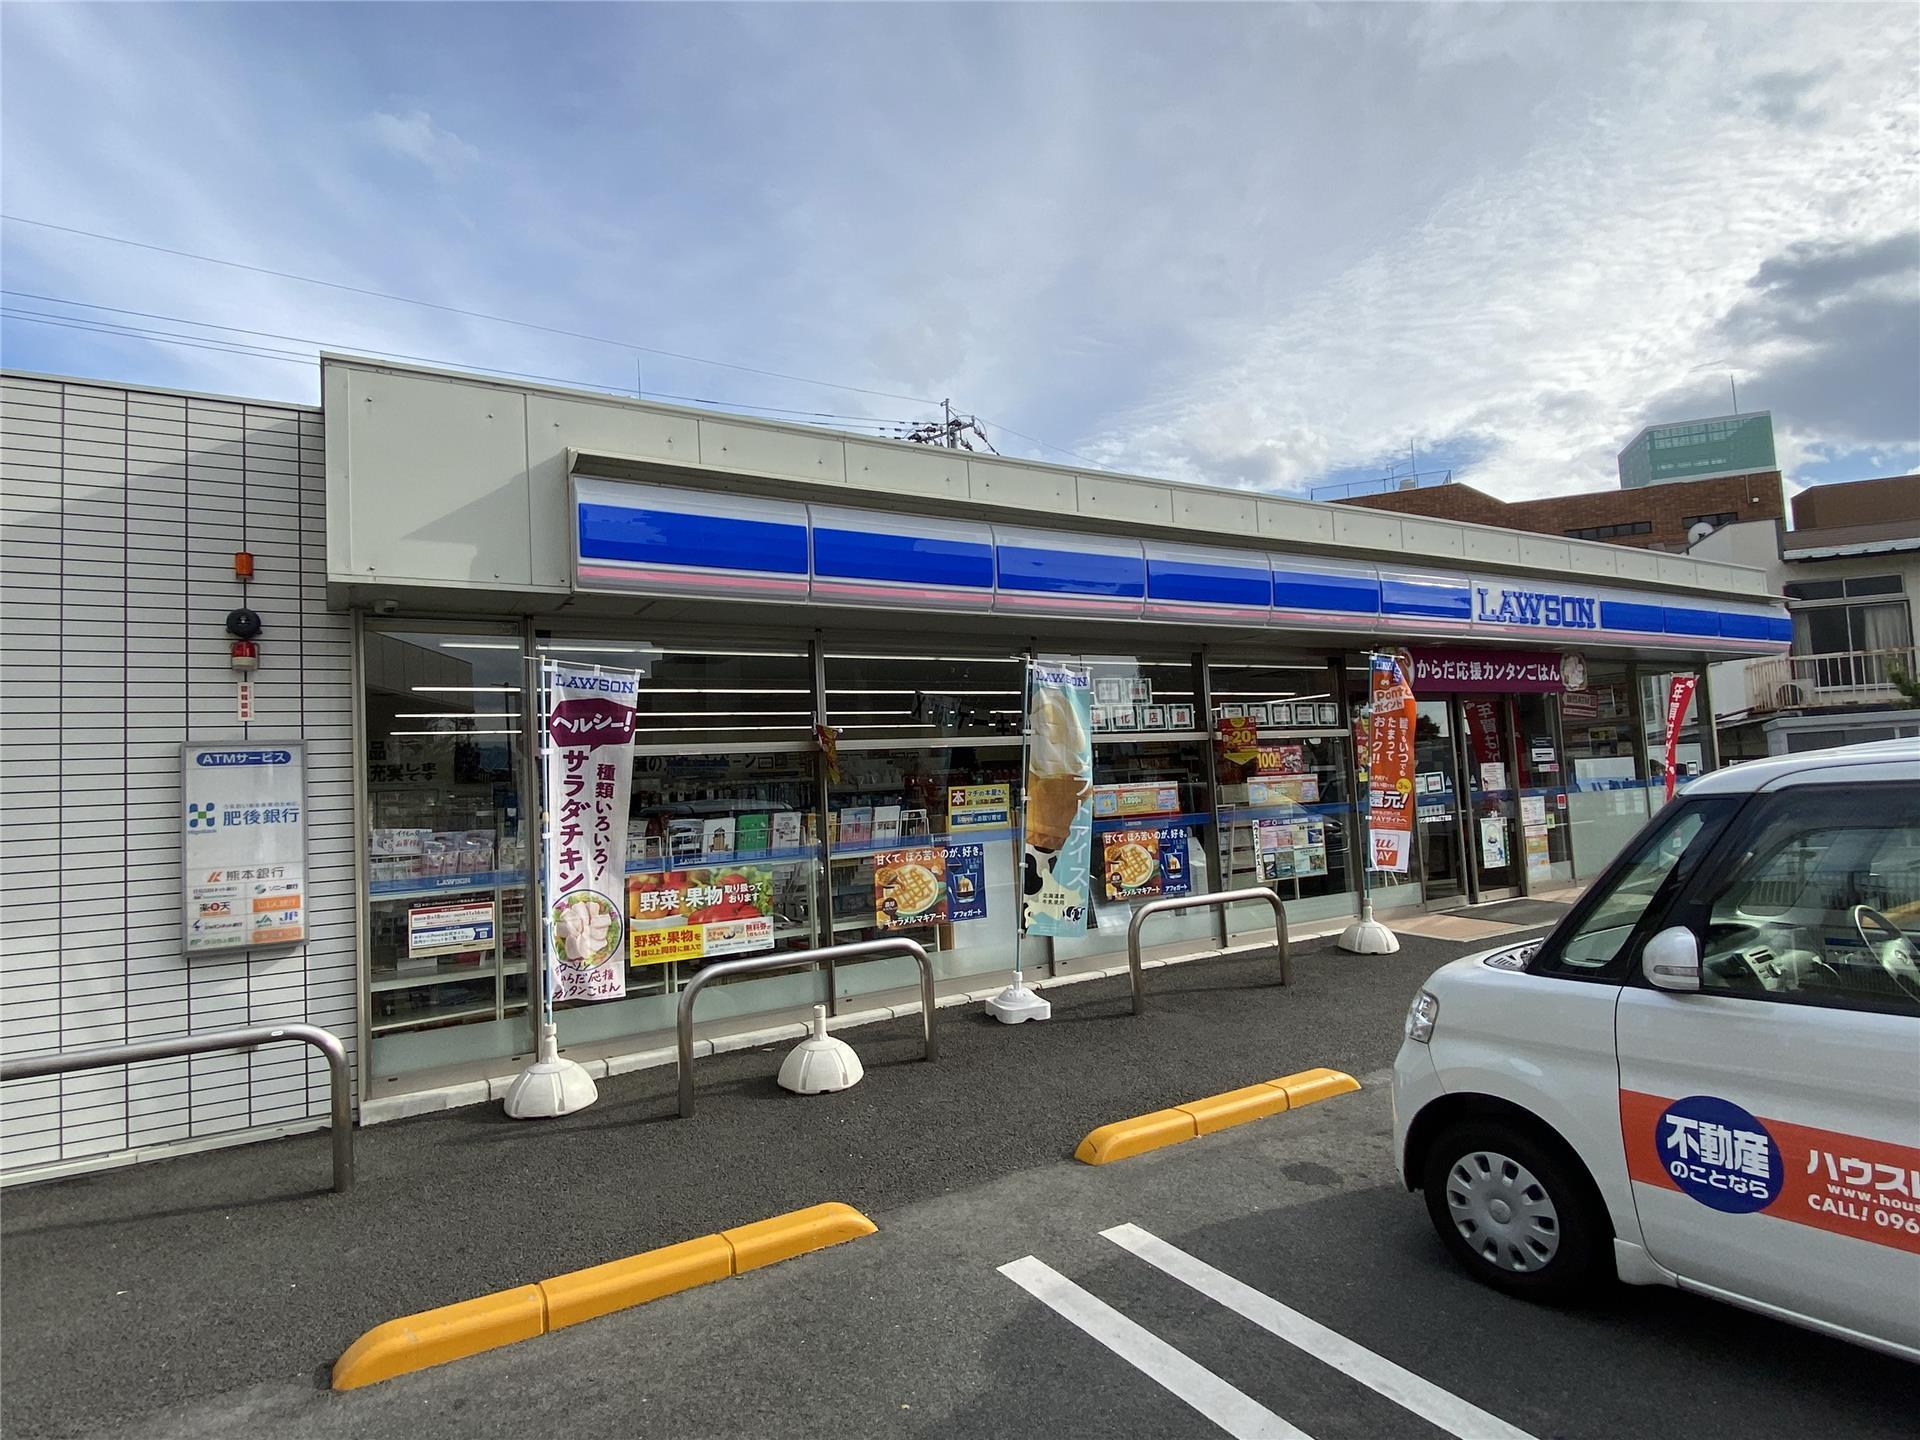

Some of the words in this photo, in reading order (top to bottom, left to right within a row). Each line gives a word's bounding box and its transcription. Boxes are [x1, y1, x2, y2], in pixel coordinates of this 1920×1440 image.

[1477, 587, 1596, 628] LAWSON
[1036, 671, 1087, 687] LAWSON
[1416, 659, 1560, 681] からだ応援カンタンごはん
[555, 674, 634, 694] LAWSON
[1375, 702, 1403, 712] ポイント
[552, 711, 633, 733] ヘルシー!
[1386, 716, 1397, 762] たまって
[202, 752, 286, 764] ATMサービス
[952, 790, 965, 805] 本
[223, 808, 300, 826] 肥後銀行
[560, 750, 591, 893] サラダチキン
[593, 763, 615, 881] 種類いろいろ!
[875, 846, 984, 866] 甘くて、ほろ苦いのが、好き。
[226, 866, 285, 881] 熊本銀行
[724, 882, 763, 894] 取り扱って
[728, 892, 759, 904] おります
[1165, 884, 1188, 892] アフォガート
[640, 884, 723, 913] 野菜・果物
[885, 912, 947, 928] キャラメルマキアート
[953, 909, 982, 919] アフォガート
[1666, 1113, 1770, 1179] 不動産
[1669, 1160, 1769, 1199] のことなら
[1807, 1149, 1920, 1200] ハウス
[1808, 1194, 1868, 1221] CALL!
[1874, 1209, 1920, 1234] 096
